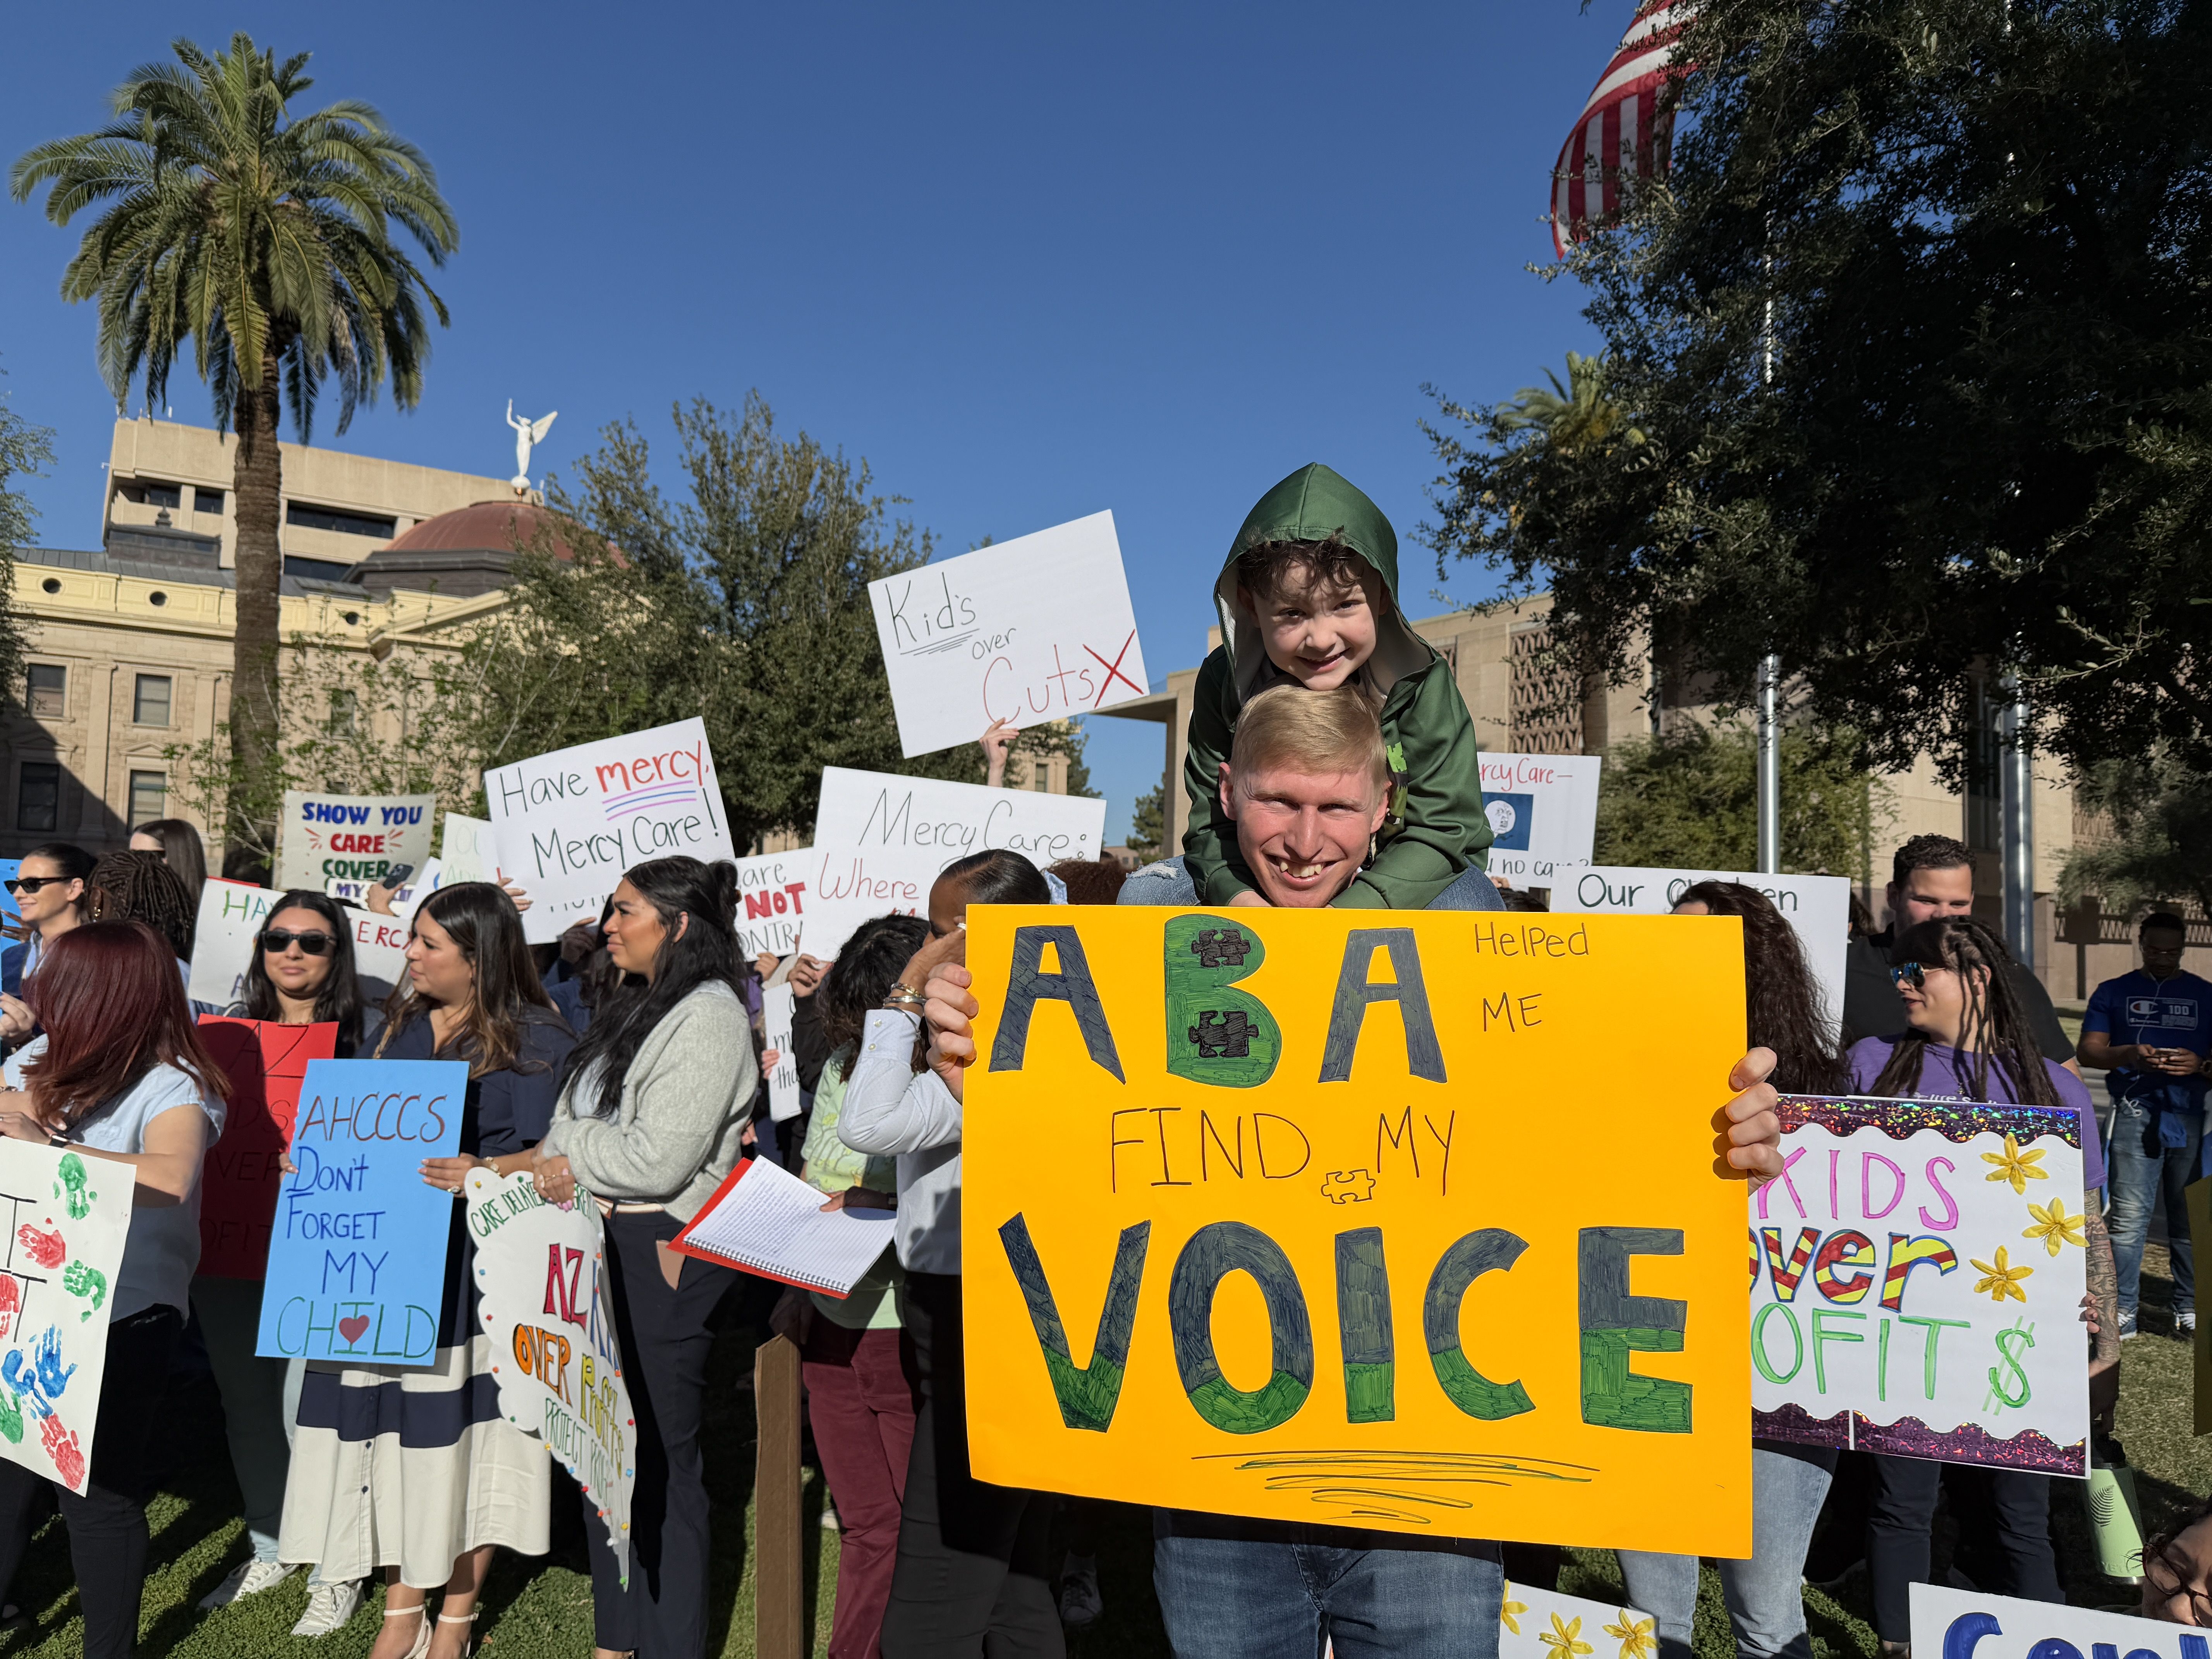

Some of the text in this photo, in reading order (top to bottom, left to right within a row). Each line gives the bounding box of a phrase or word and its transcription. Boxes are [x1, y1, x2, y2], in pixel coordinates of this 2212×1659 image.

[885, 572, 976, 649] Kid's
[972, 628, 1017, 659] over
[984, 644, 1094, 725] Cuts
[500, 766, 588, 817] Have
[1480, 763, 1513, 792] rcy
[1516, 757, 1554, 784] Care
[302, 801, 424, 826] SHOW YOU
[858, 788, 1087, 873] Mercy Care:
[330, 832, 386, 854] CARE
[532, 827, 627, 879] Mercy
[1503, 859, 1525, 874] no
[322, 859, 390, 879] COVER
[336, 883, 365, 898] MY
[739, 863, 787, 890] are
[819, 852, 920, 900] Where
[1577, 873, 1645, 908] Our
[744, 881, 806, 920] NOT
[988, 914, 1448, 1088] ABA
[1483, 991, 1543, 1032] ME
[2168, 1005, 2190, 1015] 100
[225, 1021, 309, 1079] AZ
[232, 1096, 291, 1133] DS
[298, 1091, 448, 1142] AHCCCS
[1111, 1105, 1456, 1197] FIND MY
[1757, 1146, 1960, 1231] KIDS
[287, 1192, 386, 1240] FORGET
[471, 1199, 510, 1237] CARE
[322, 1249, 389, 1295] MY
[543, 1242, 588, 1335] AZ
[1749, 1226, 1959, 1313] ver
[277, 1296, 436, 1359] CHILD
[997, 1211, 1694, 1436] VOICE
[513, 1323, 573, 1408] OVER
[545, 1397, 587, 1470] PROTECT
